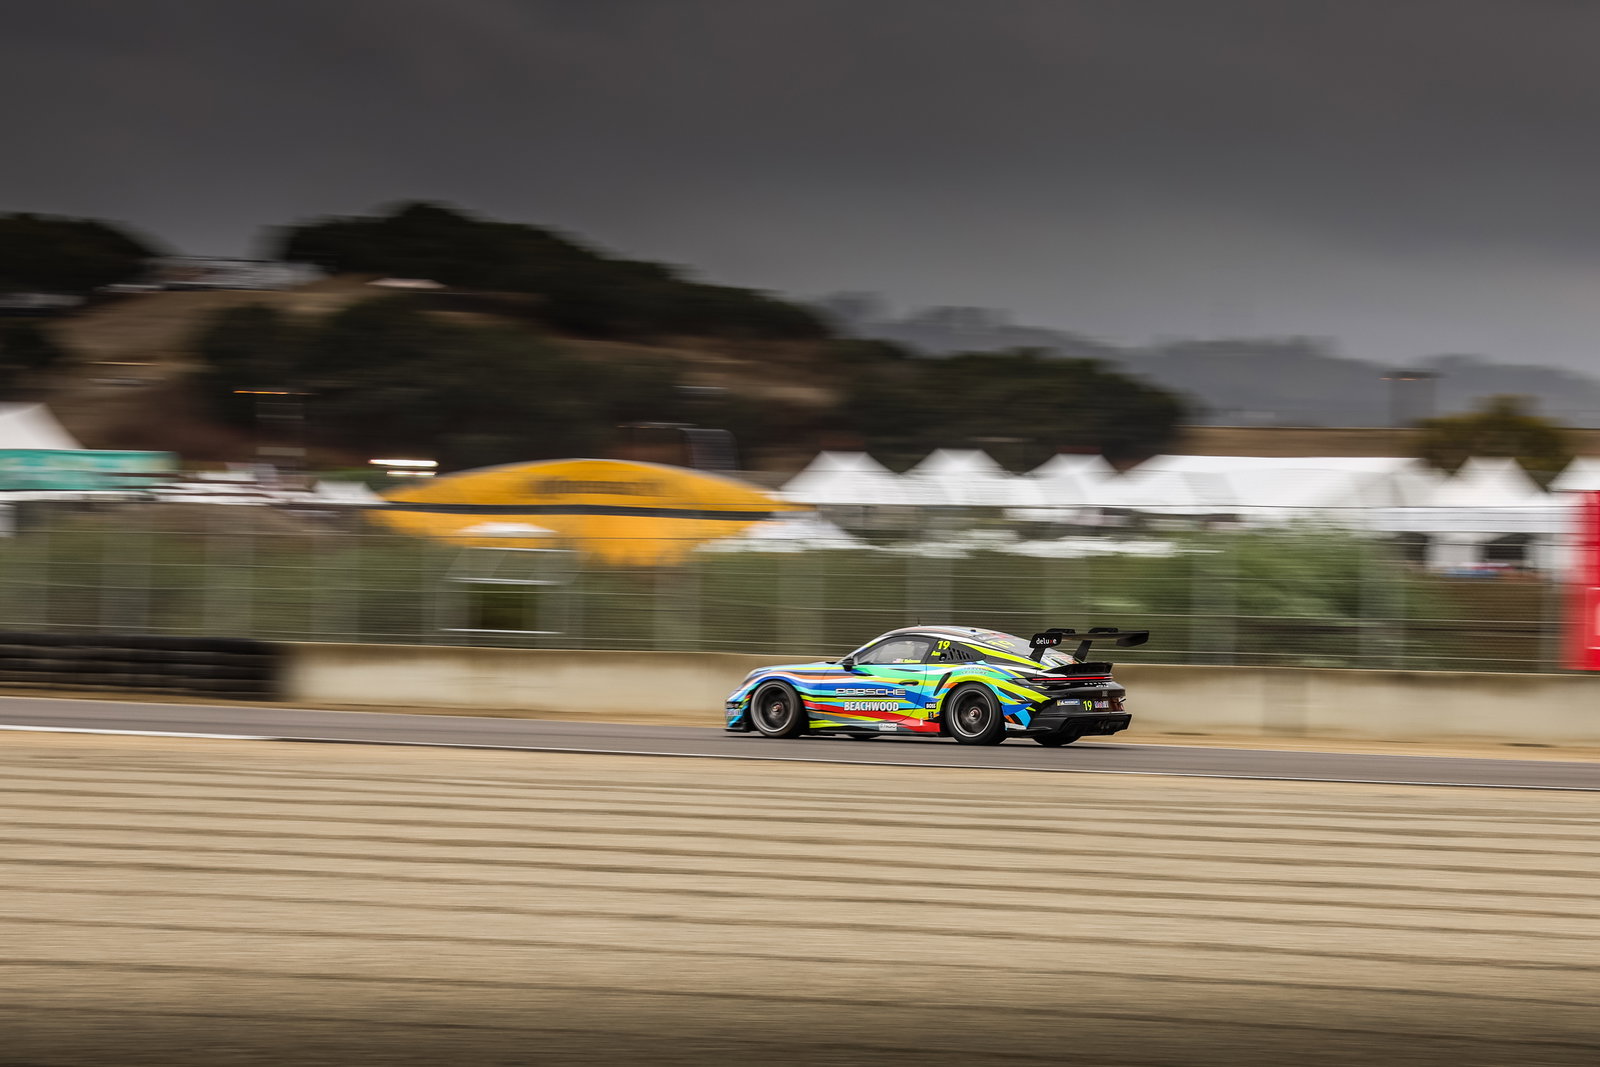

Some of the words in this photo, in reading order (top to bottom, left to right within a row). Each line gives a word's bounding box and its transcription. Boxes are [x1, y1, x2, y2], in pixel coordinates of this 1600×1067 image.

[937, 640, 951, 650] 19
[835, 688, 906, 696] PORSCHE
[843, 701, 899, 712] BEACHWOOD
[1083, 700, 1093, 711] 19
